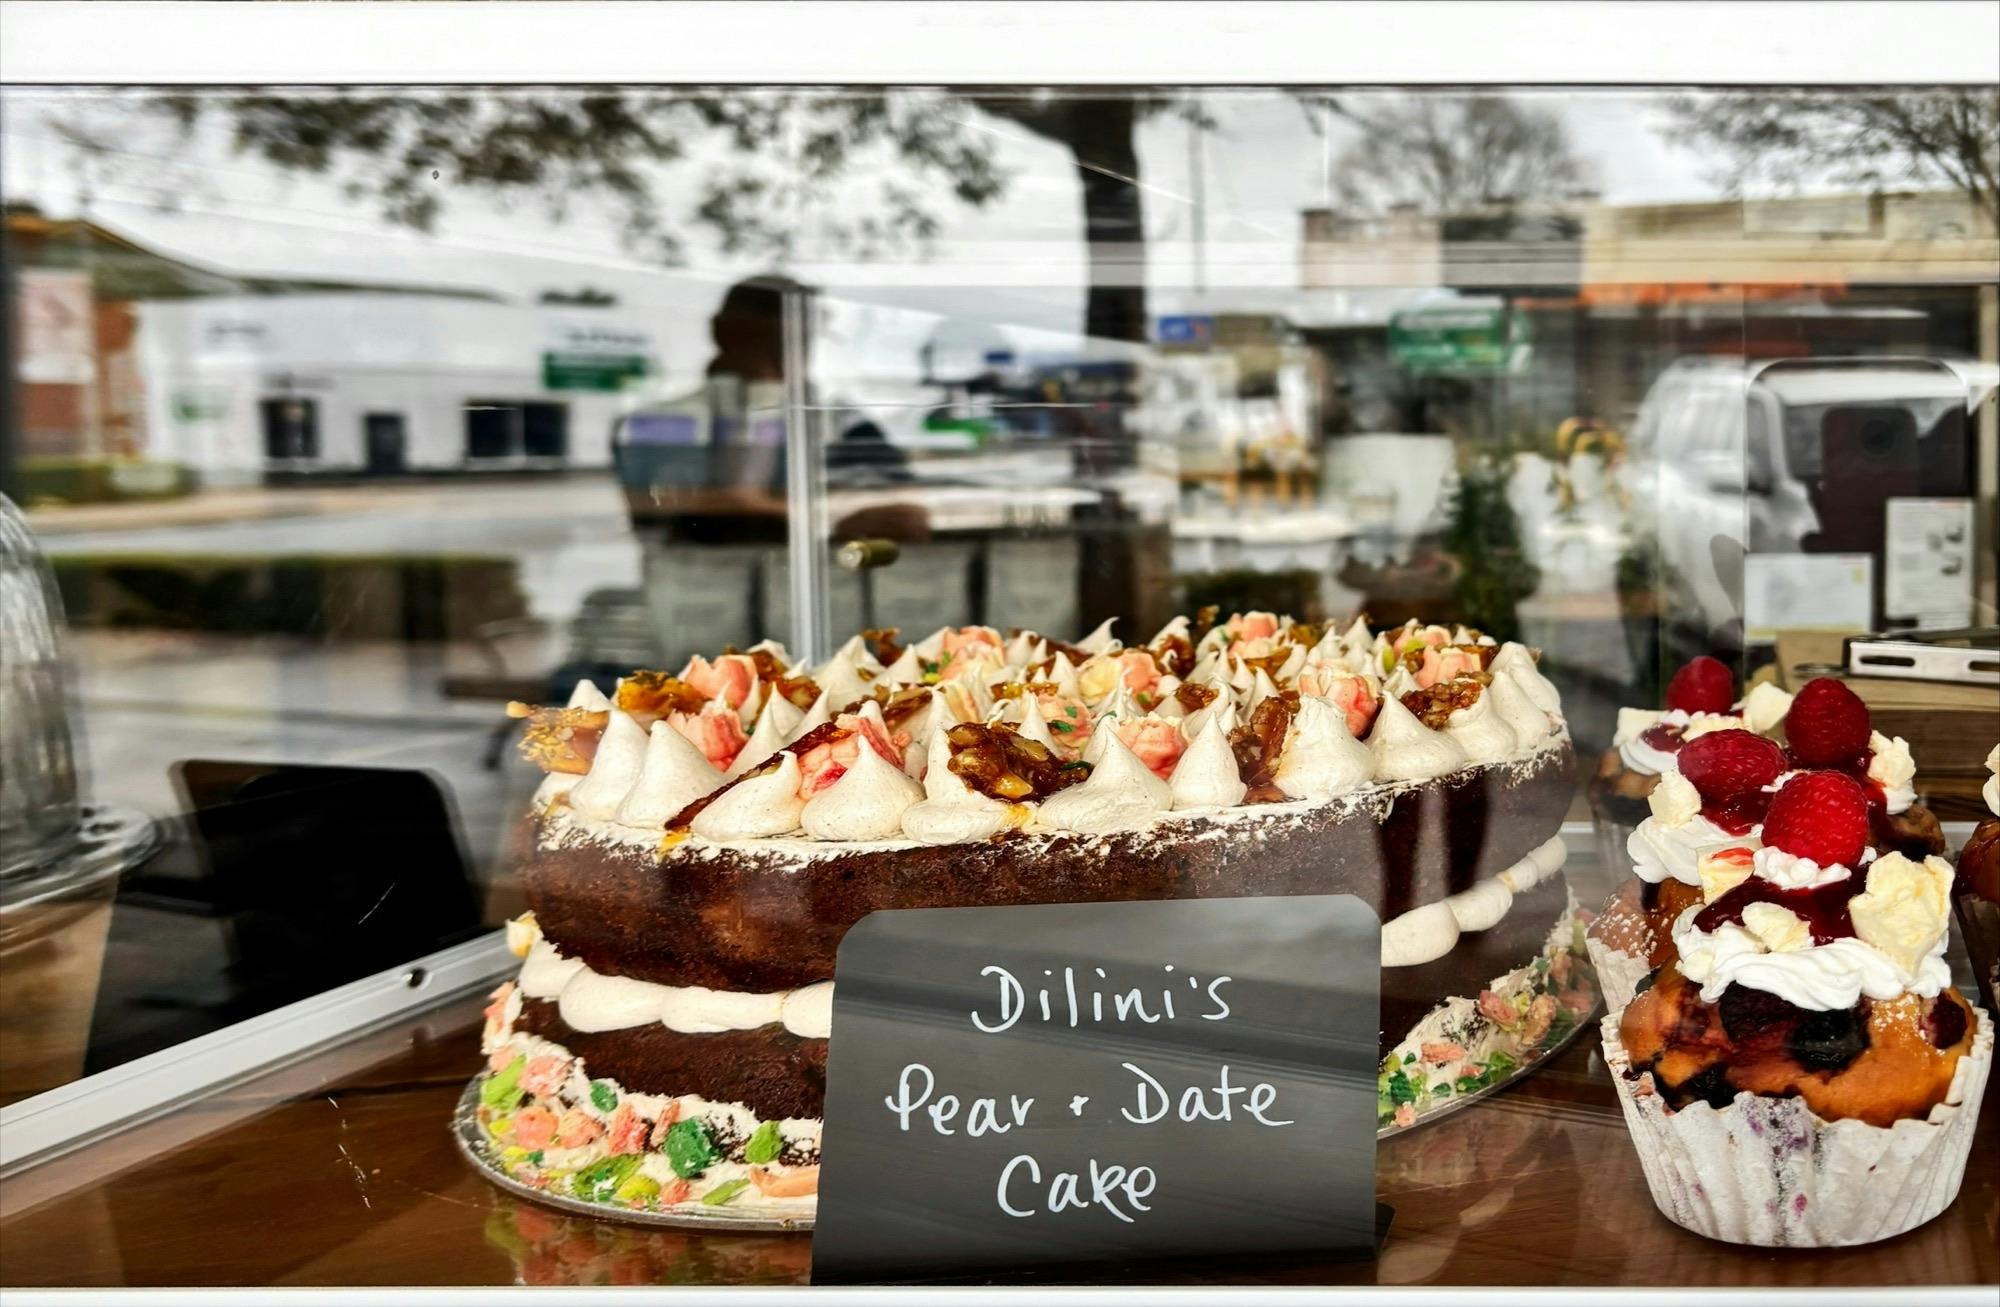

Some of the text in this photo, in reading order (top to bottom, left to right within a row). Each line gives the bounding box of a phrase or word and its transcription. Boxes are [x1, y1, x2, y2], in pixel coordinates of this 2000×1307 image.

[971, 964, 1232, 1033] Dilini's
[884, 1063, 1035, 1137] Pear
[1120, 1062, 1295, 1127] Date
[997, 1154, 1157, 1223] Cake
